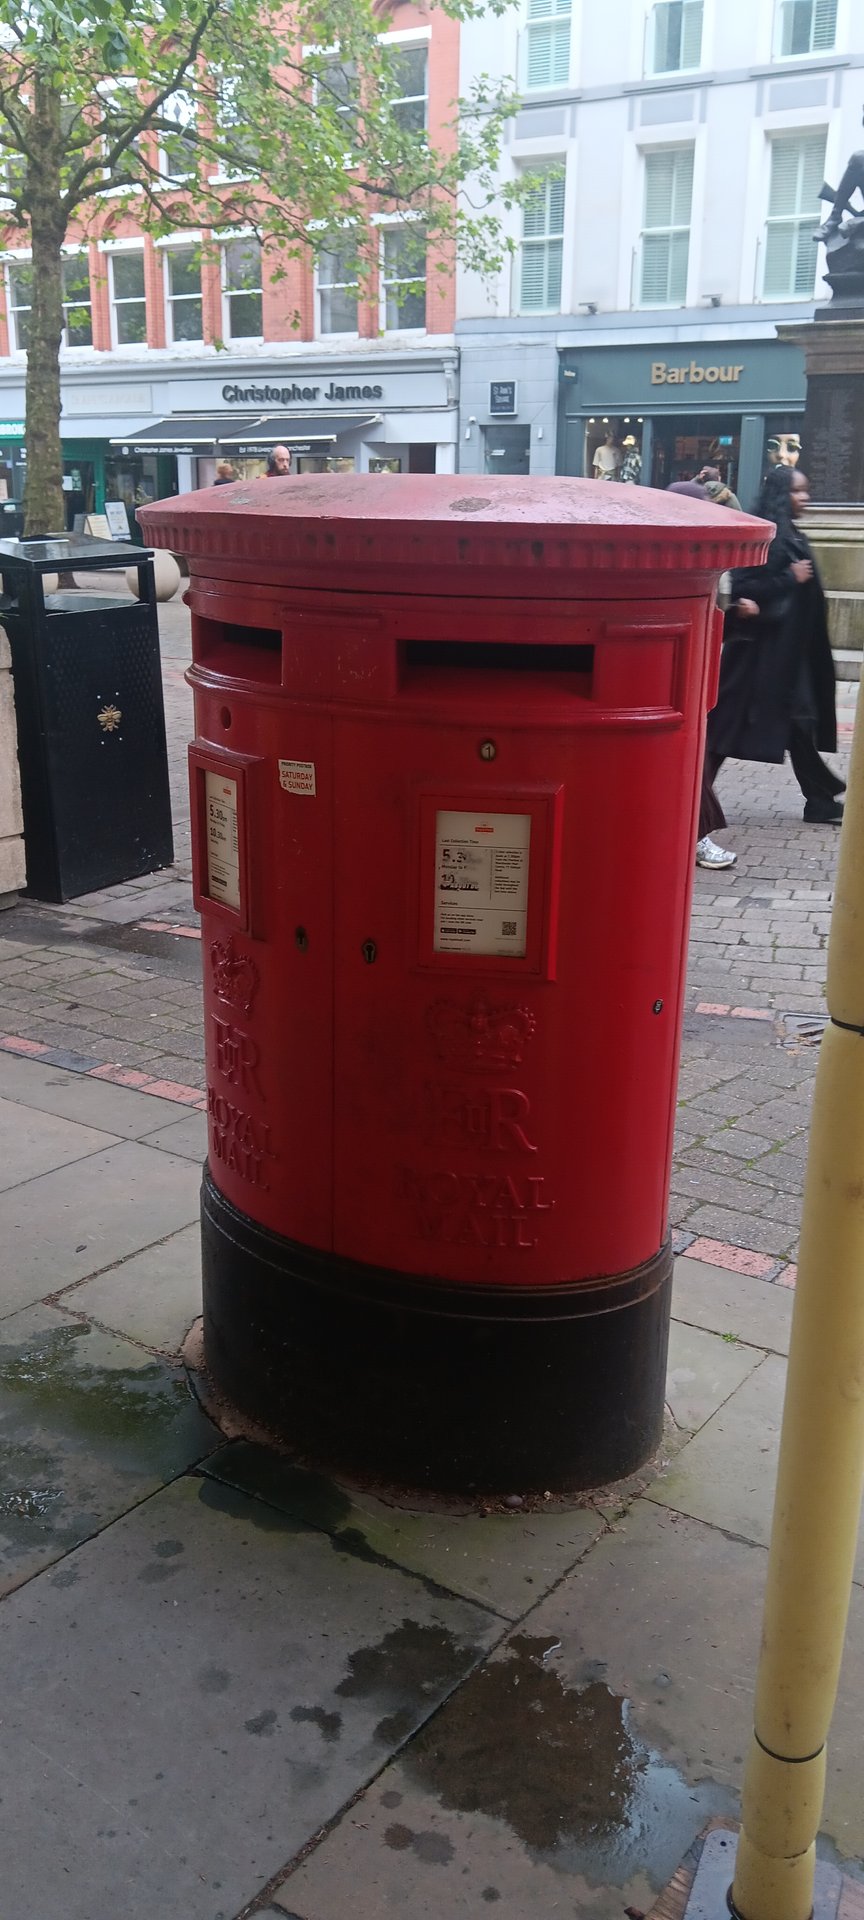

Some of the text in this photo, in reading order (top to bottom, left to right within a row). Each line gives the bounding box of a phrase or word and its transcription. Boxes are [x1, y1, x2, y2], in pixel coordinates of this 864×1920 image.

[651, 360, 744, 384] Barbour
[222, 382, 383, 405] Christopher James
[282, 771, 313, 781] SATURDAY
[283, 780, 313, 791] & SUNDAY
[206, 1085, 278, 1159] ROYAL
[212, 1122, 270, 1192] MAIL
[394, 1164, 556, 1211] ROYAL
[414, 1210, 539, 1249] MAIL
